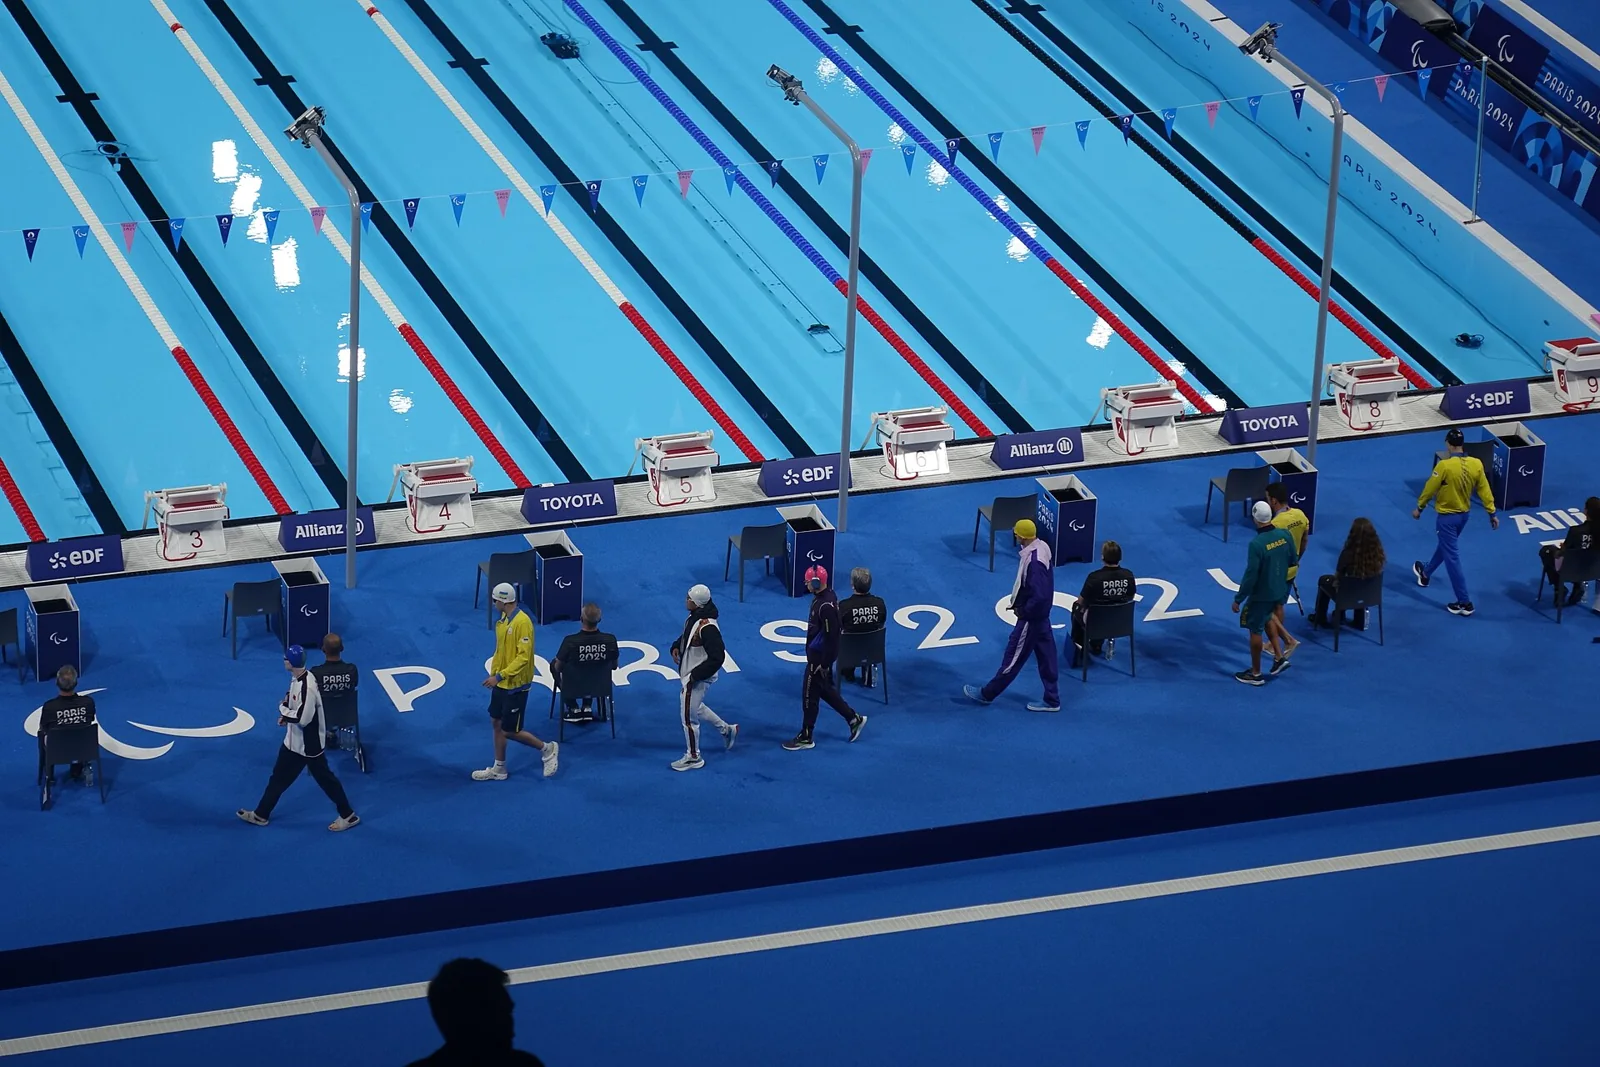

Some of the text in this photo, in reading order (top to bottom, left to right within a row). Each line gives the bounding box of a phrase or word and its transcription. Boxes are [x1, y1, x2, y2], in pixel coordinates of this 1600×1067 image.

[1170, 13, 1210, 51] 2024
[1486, 102, 1514, 131] 2024
[1390, 192, 1436, 236] 2024
[1587, 376, 1599, 393] 9
[1369, 400, 1381, 417] 8
[1240, 414, 1299, 433] TOYOTA
[1144, 425, 1156, 443] 7
[916, 450, 927, 467] 6
[1010, 441, 1055, 458] Allianz
[680, 475, 692, 493] 5
[439, 502, 451, 520] 4
[540, 493, 603, 512] TOYOTA
[295, 522, 344, 538] Allianz
[1038, 511, 1054, 533] 2024
[1509, 508, 1587, 534] Alli
[189, 529, 203, 548] 3
[1266, 538, 1287, 551] BRASIL
[1103, 588, 1128, 597] 2024
[852, 615, 879, 625] 2024
[579, 653, 606, 662] 2024
[323, 683, 351, 692] 2024
